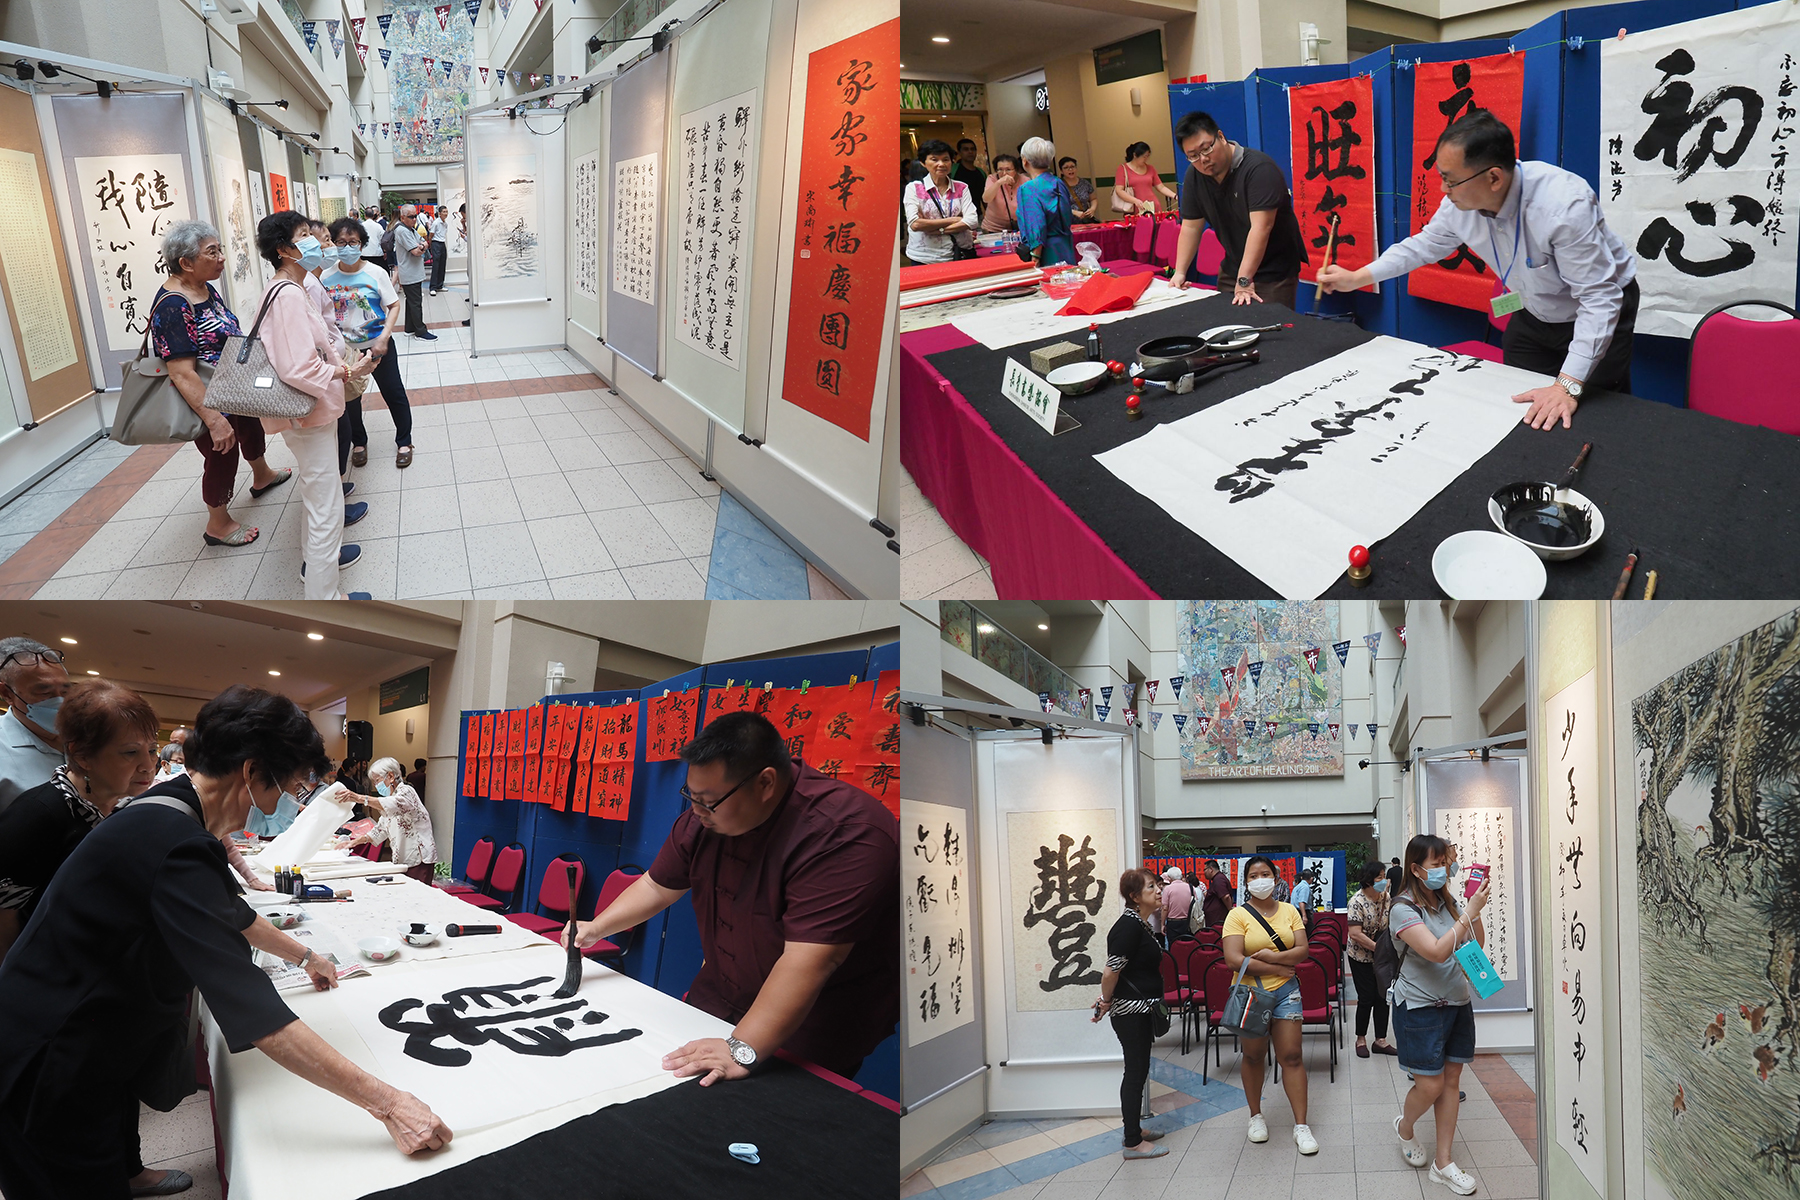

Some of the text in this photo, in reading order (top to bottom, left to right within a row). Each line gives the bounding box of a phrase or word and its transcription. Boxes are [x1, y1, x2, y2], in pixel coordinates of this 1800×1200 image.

[1633, 48, 1765, 278] 初心
[609, 713, 632, 814] 龍馬精神
[1209, 766, 1229, 777] THE
[1228, 766, 1248, 776] ART
[1249, 765, 1263, 776] OF
[1263, 765, 1304, 776] HEALING
